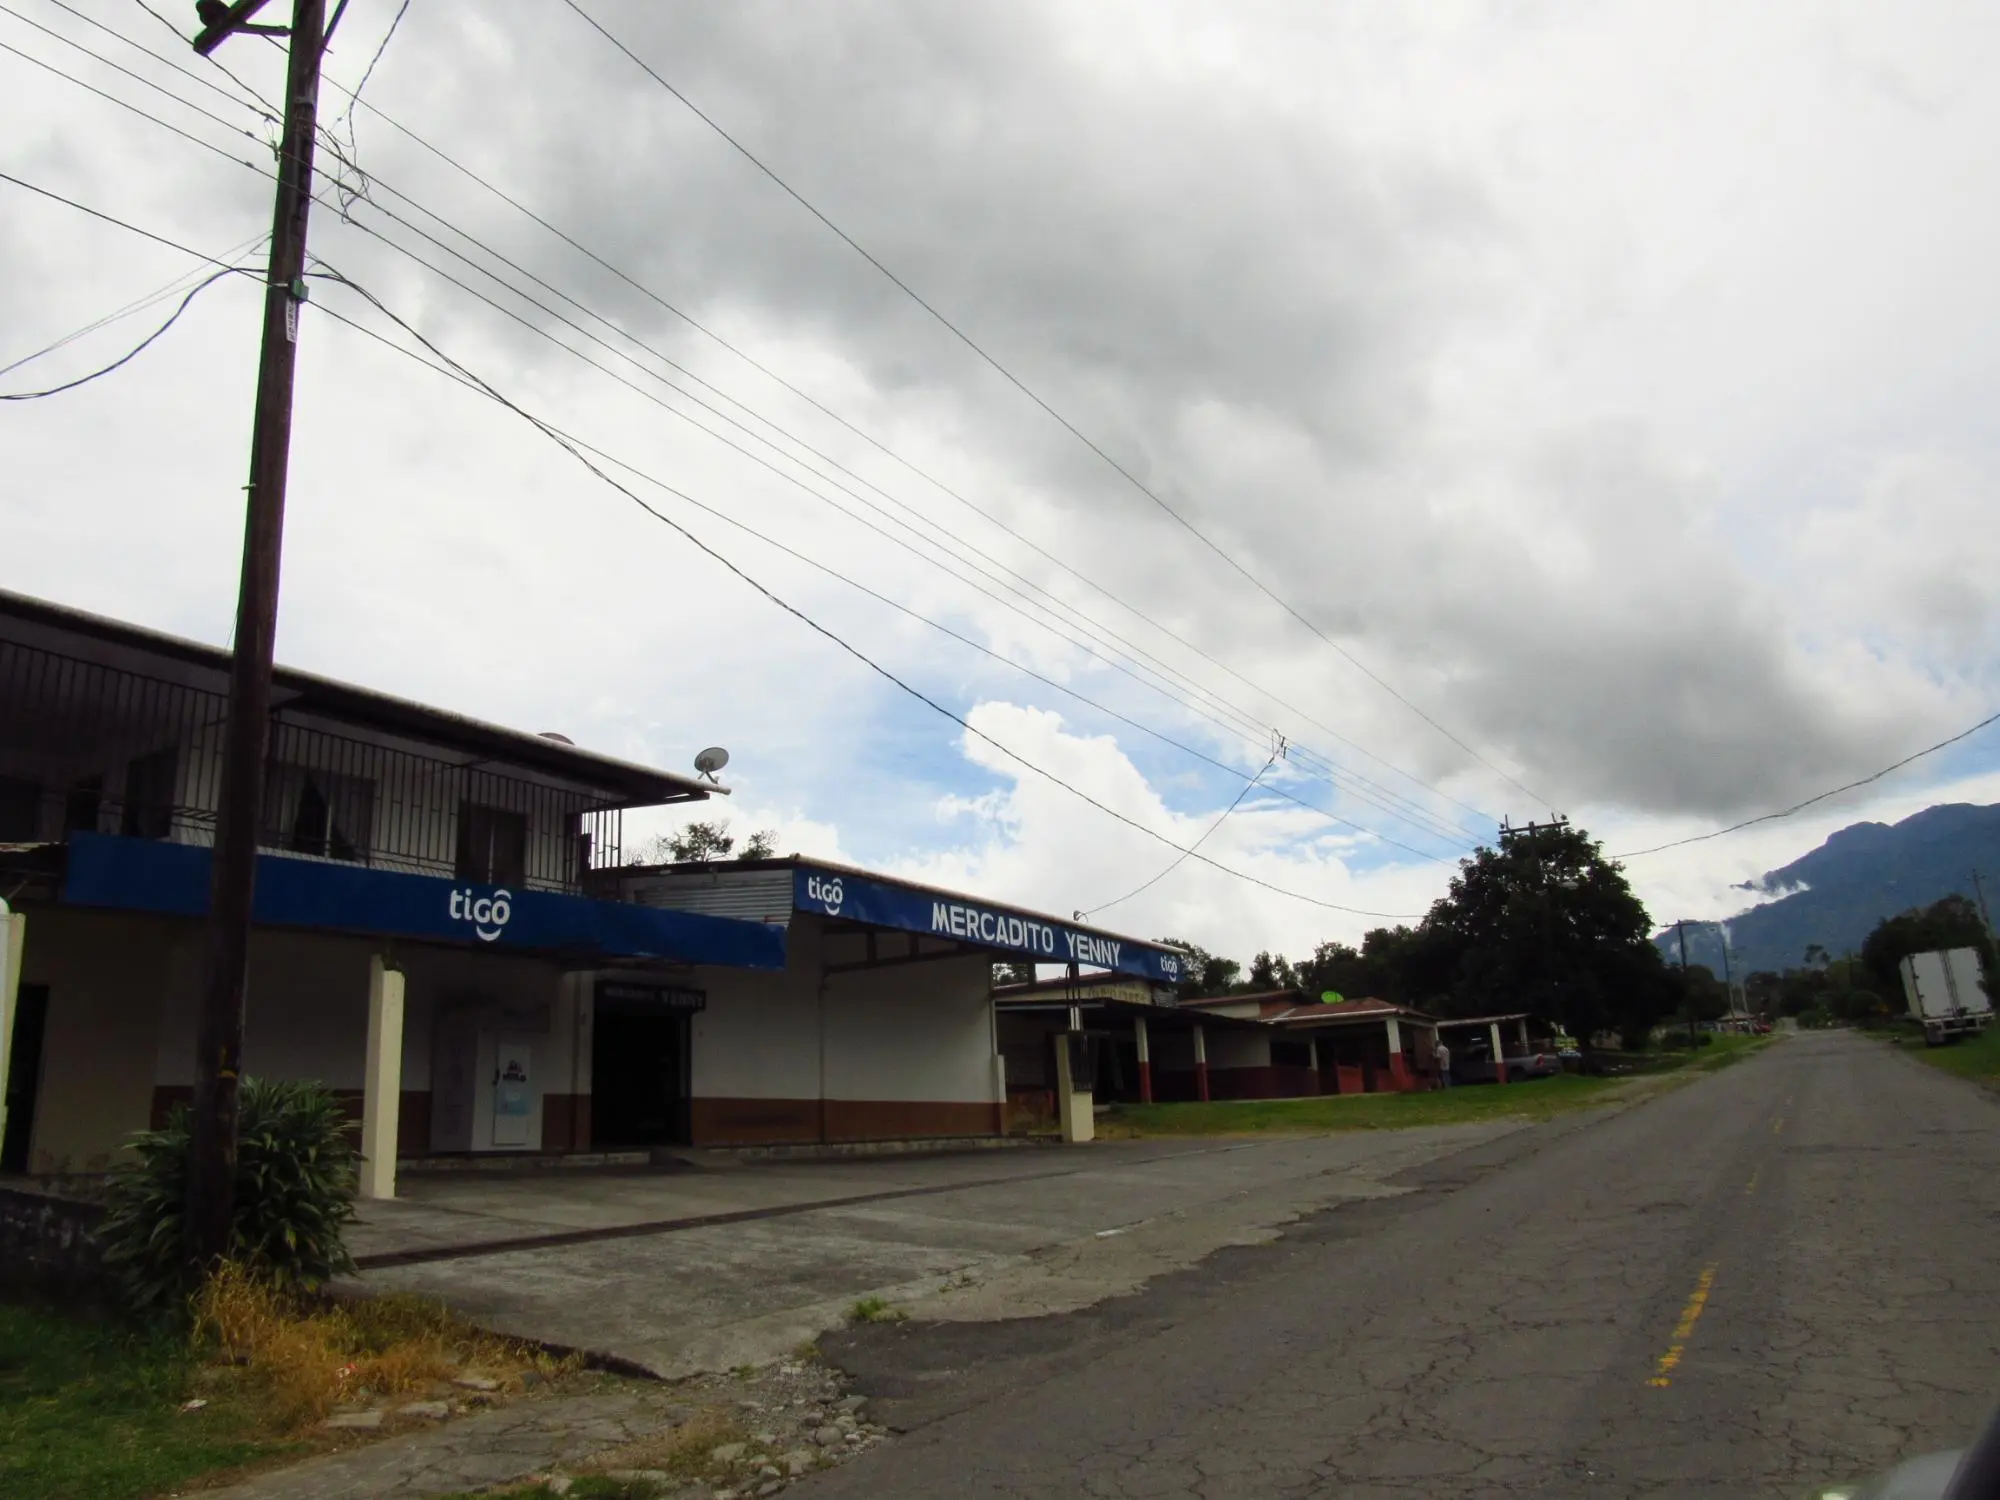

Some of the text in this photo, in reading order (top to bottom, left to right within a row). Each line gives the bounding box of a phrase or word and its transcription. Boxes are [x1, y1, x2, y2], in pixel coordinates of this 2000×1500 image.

[449, 889, 512, 941] tigo
[808, 876, 844, 916] tigo
[931, 902, 1121, 967] MERCADITO YENNY
